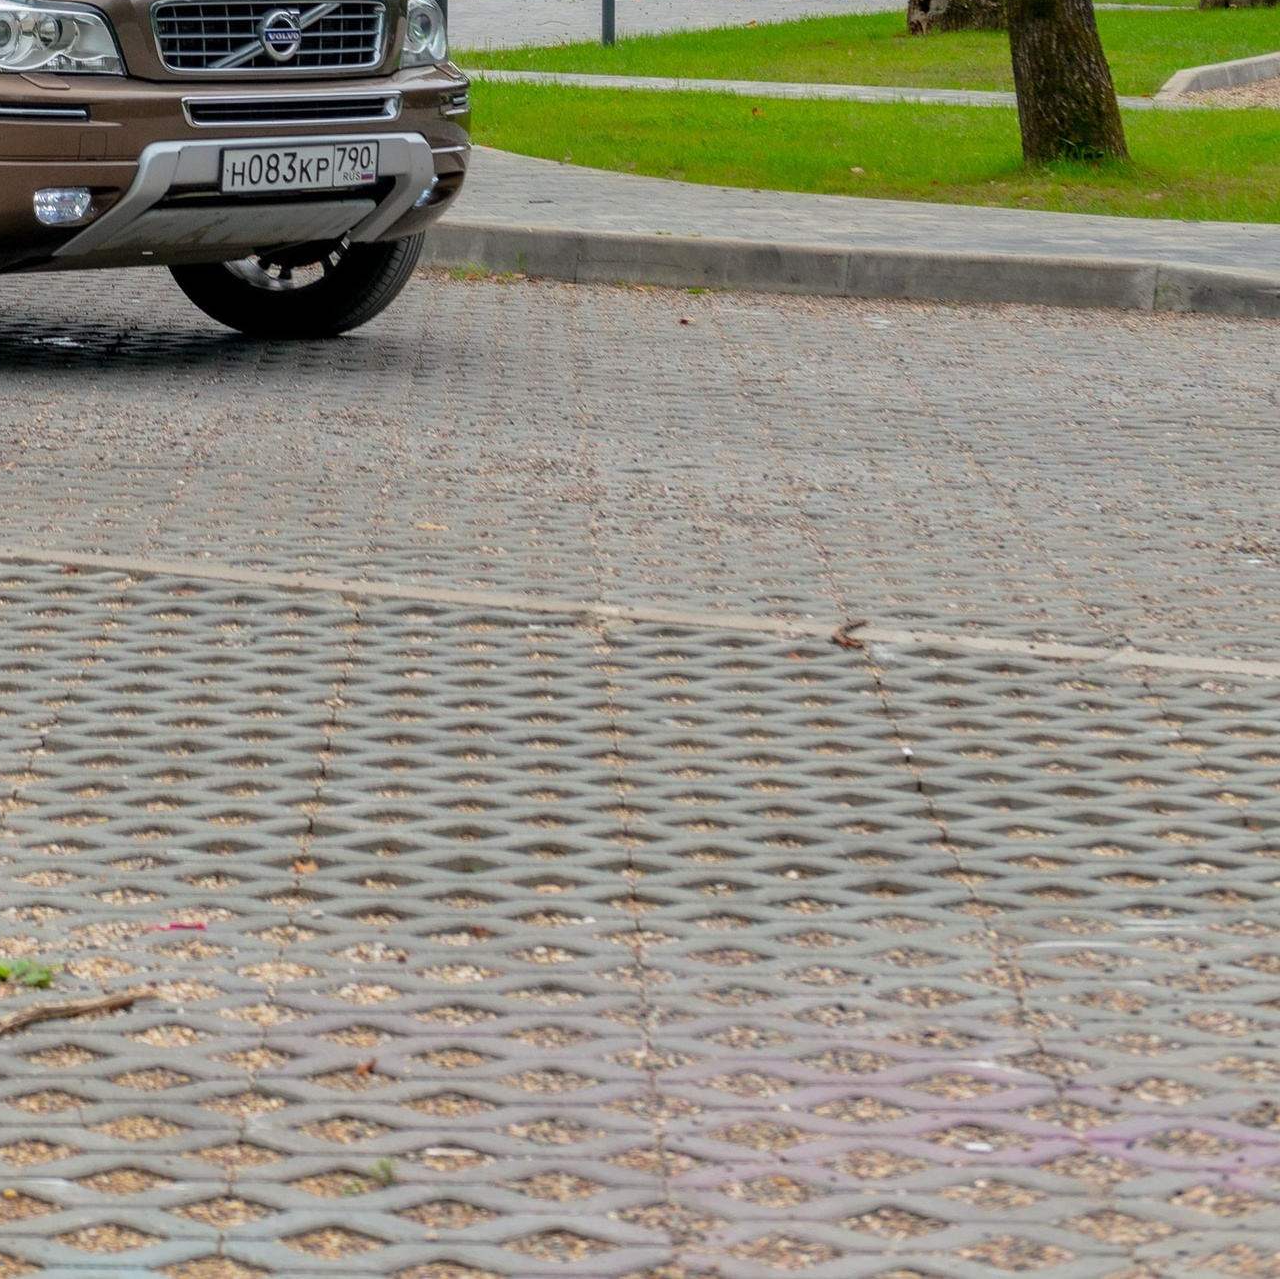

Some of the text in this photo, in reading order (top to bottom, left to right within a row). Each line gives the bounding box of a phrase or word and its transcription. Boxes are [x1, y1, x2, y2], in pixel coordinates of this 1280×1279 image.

[268, 32, 299, 40] VOLVO
[337, 146, 371, 172] 790
[343, 171, 361, 181] RUS
